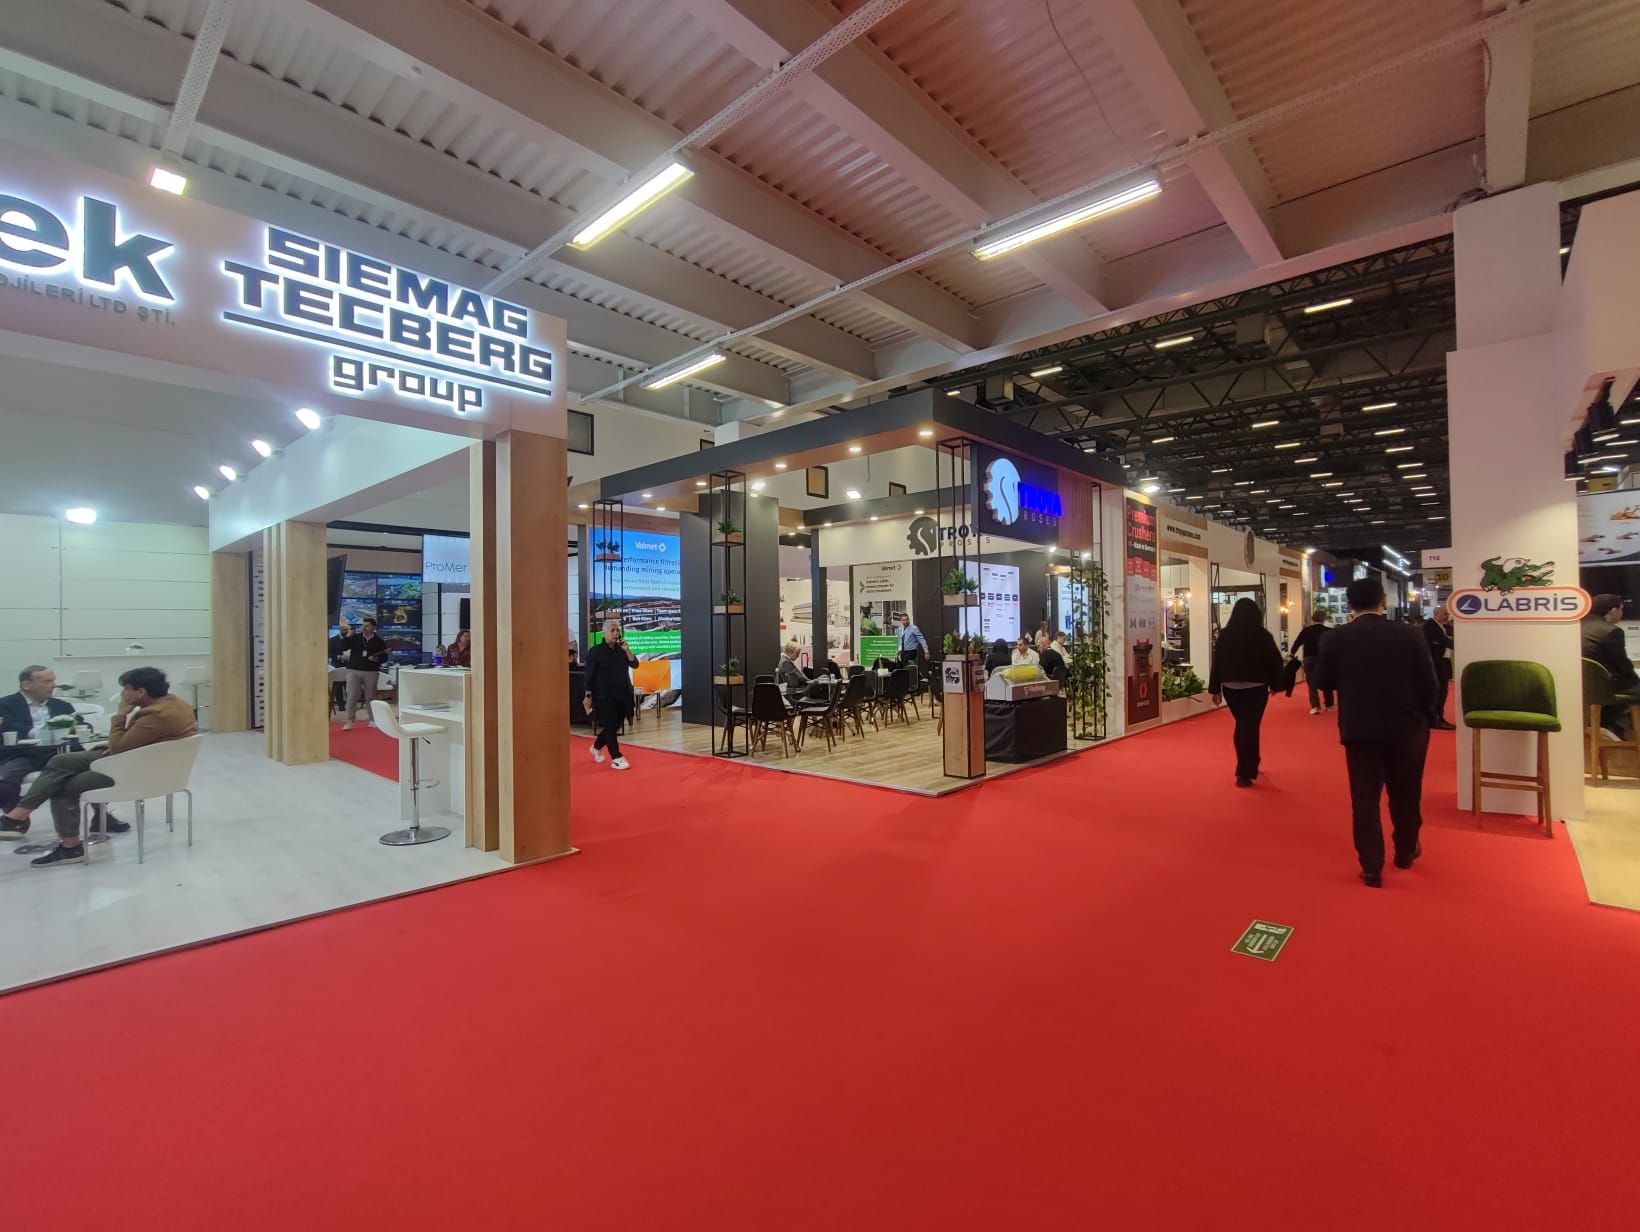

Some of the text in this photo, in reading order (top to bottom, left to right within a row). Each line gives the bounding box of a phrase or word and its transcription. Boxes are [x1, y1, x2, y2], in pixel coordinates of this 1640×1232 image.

[0, 194, 175, 301] ek
[268, 226, 528, 339] SIEMAG
[90, 294, 128, 314] LTD
[137, 306, 176, 326] ŞTİ.
[224, 260, 552, 382] TECBERG
[333, 355, 483, 412] group
[623, 556, 659, 565] erformance
[635, 541, 659, 551] Valmet
[1484, 594, 1579, 612] LABRİS
